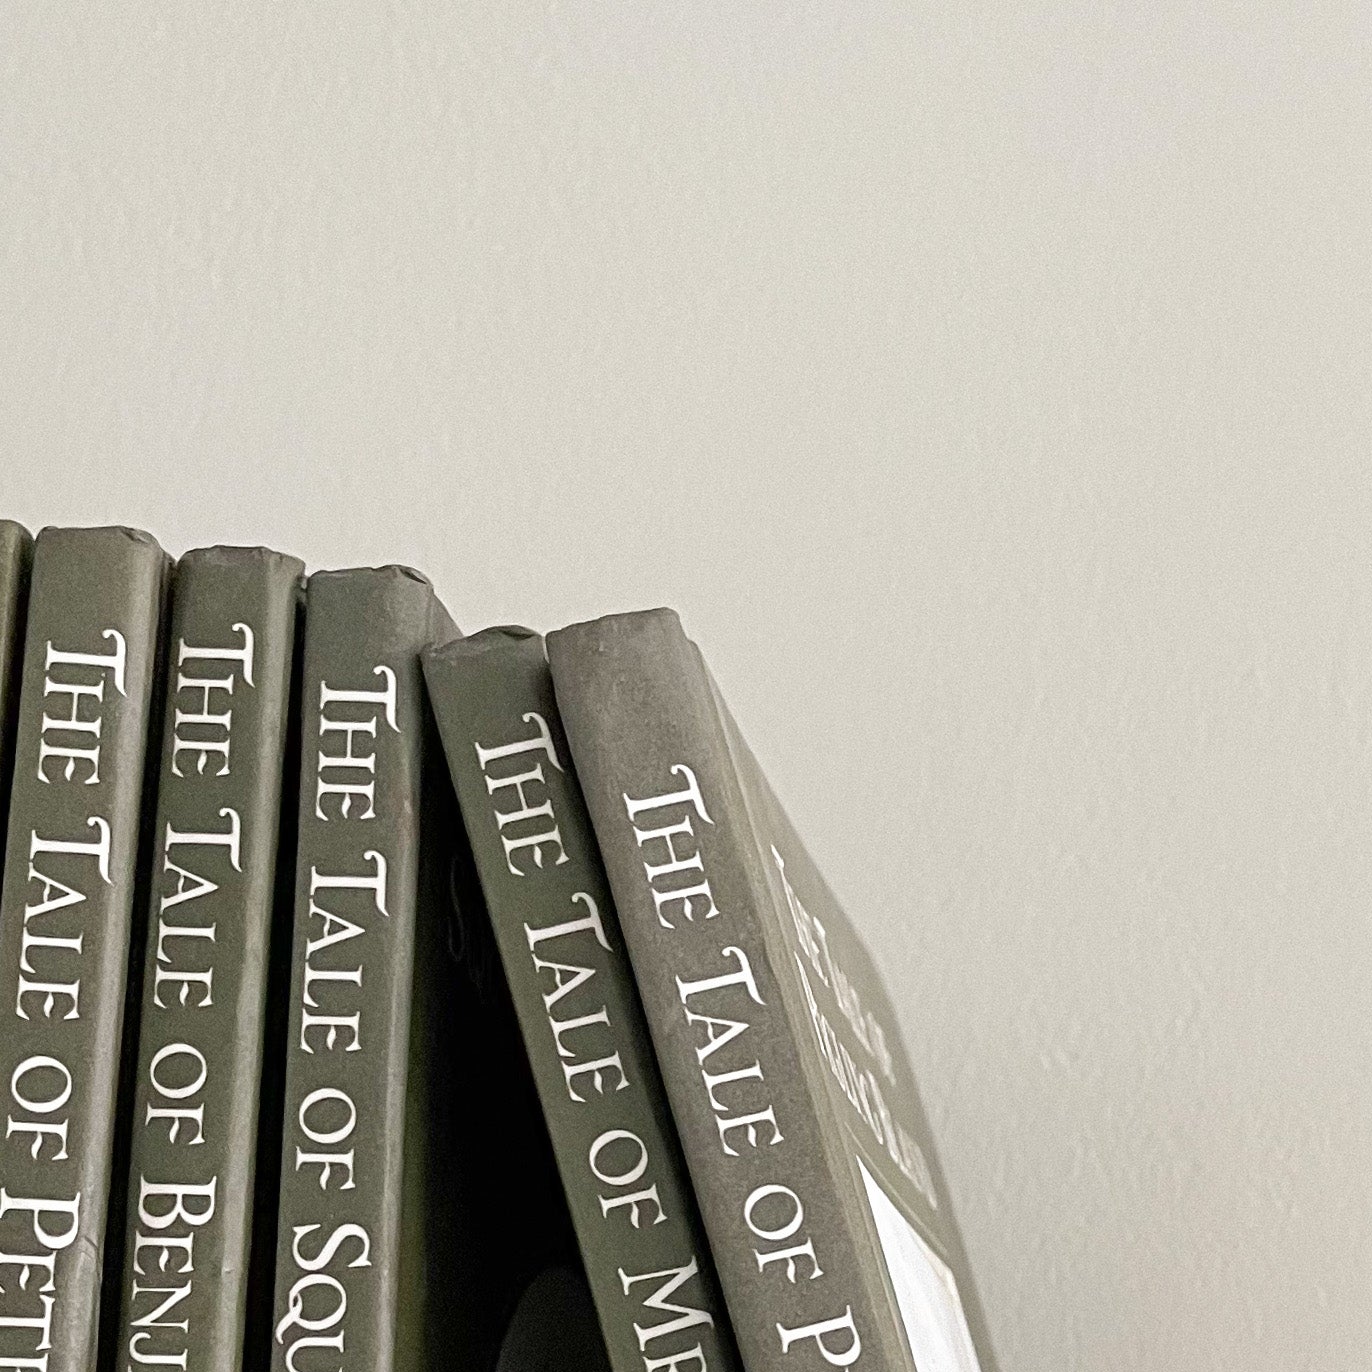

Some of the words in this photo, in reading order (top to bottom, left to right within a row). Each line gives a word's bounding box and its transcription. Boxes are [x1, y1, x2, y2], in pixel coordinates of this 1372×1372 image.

[37, 628, 128, 785] THE
[171, 622, 255, 778] THE
[315, 665, 401, 822] THE
[15, 816, 115, 1021] TALE
[153, 807, 242, 1009] TALE
[300, 850, 389, 1055] TALE
[474, 711, 570, 877] THE
[523, 892, 630, 1103] TALE
[589, 1129, 668, 1229] OF
[145, 1043, 206, 1145] OF
[622, 763, 720, 930] THE
[674, 945, 785, 1157] TALE
[743, 1184, 824, 1284] OF
[5, 1055, 71, 1161] OF
[295, 1087, 357, 1190] OF
